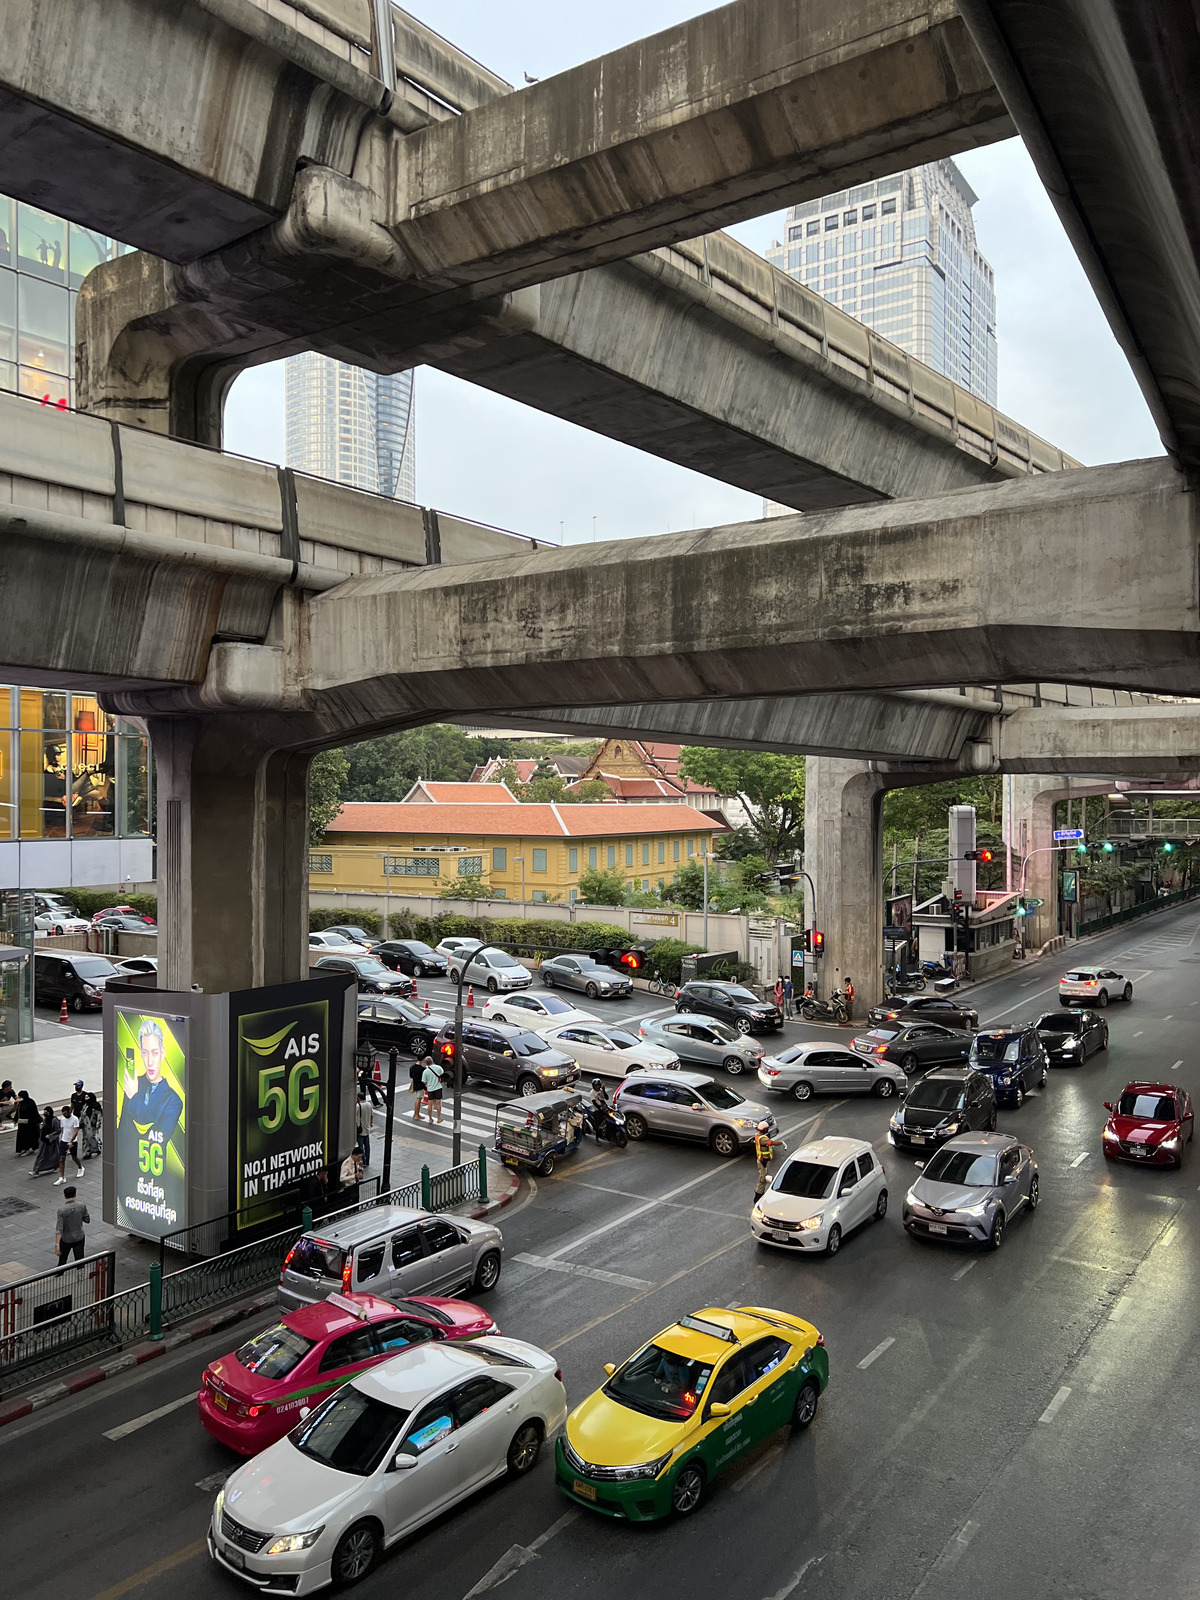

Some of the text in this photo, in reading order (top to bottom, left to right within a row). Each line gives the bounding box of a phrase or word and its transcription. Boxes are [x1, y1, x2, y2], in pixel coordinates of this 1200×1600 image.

[284, 1033, 320, 1059] AIS
[258, 1058, 320, 1134] 5G
[148, 1129, 164, 1143] AIS
[138, 1139, 164, 1176] 5G
[244, 1141, 323, 1178] NO.1 NETWORK
[137, 1177, 165, 1203] เร็วที่สุด
[244, 1178, 258, 1198] IN
[125, 1196, 177, 1226] ครอบคลุมที่สุด
